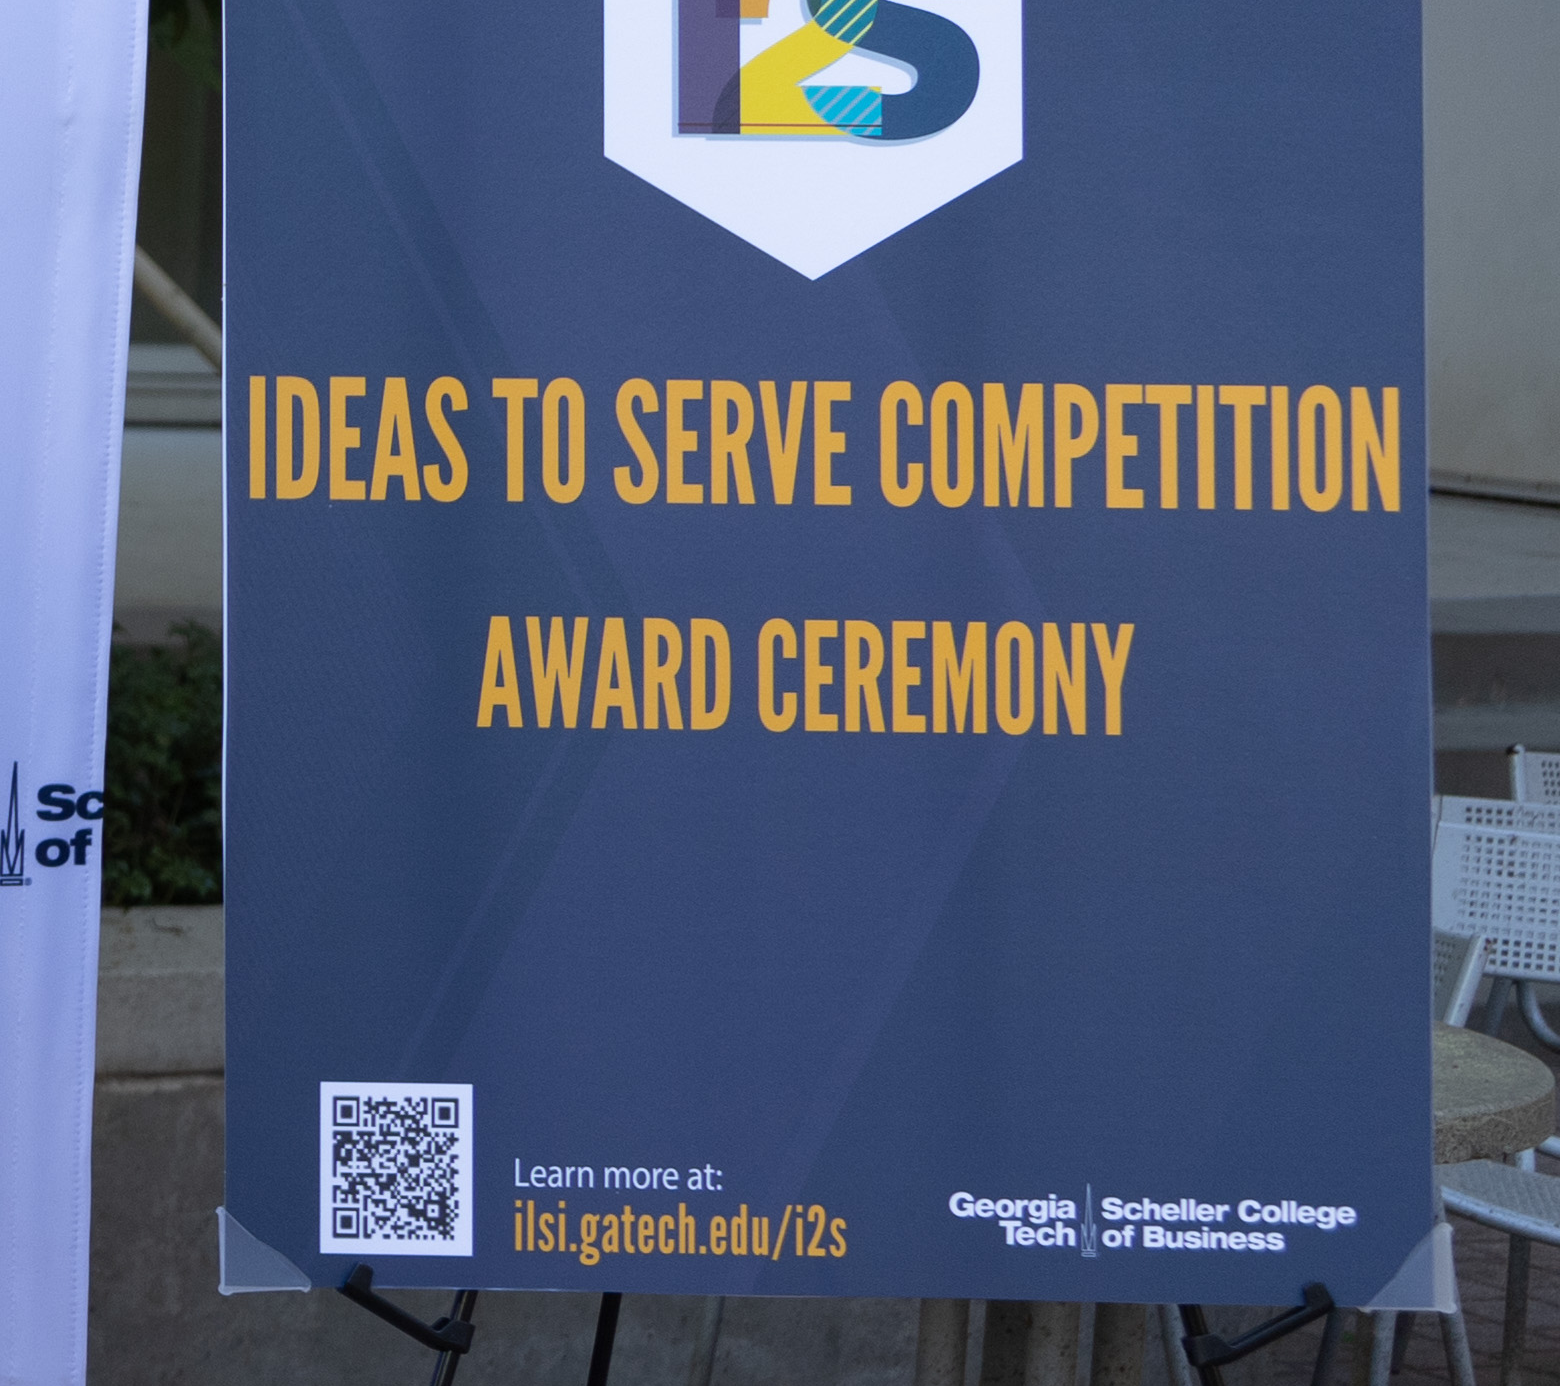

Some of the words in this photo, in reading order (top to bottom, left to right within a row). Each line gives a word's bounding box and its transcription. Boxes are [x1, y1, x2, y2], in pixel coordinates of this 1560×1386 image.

[250, 376, 468, 502] IDEAS
[493, 378, 584, 503] TO
[614, 379, 851, 505] SERVE
[881, 381, 1399, 511] COMPETITION
[477, 616, 730, 729] AWARD
[759, 619, 1134, 735] CEREMONY
[36, 829, 92, 867] of
[515, 1159, 593, 1187] Learn
[604, 1167, 679, 1189] more
[687, 1164, 722, 1190] at:
[949, 1192, 1076, 1224] Georgia
[1102, 1197, 1230, 1222] Scheller
[1238, 1200, 1357, 1229] College
[516, 1200, 846, 1265] ilsi.gatech.edu/i2s
[999, 1221, 1076, 1246] Tech
[1102, 1225, 1135, 1247] of
[1143, 1226, 1285, 1250] Business
